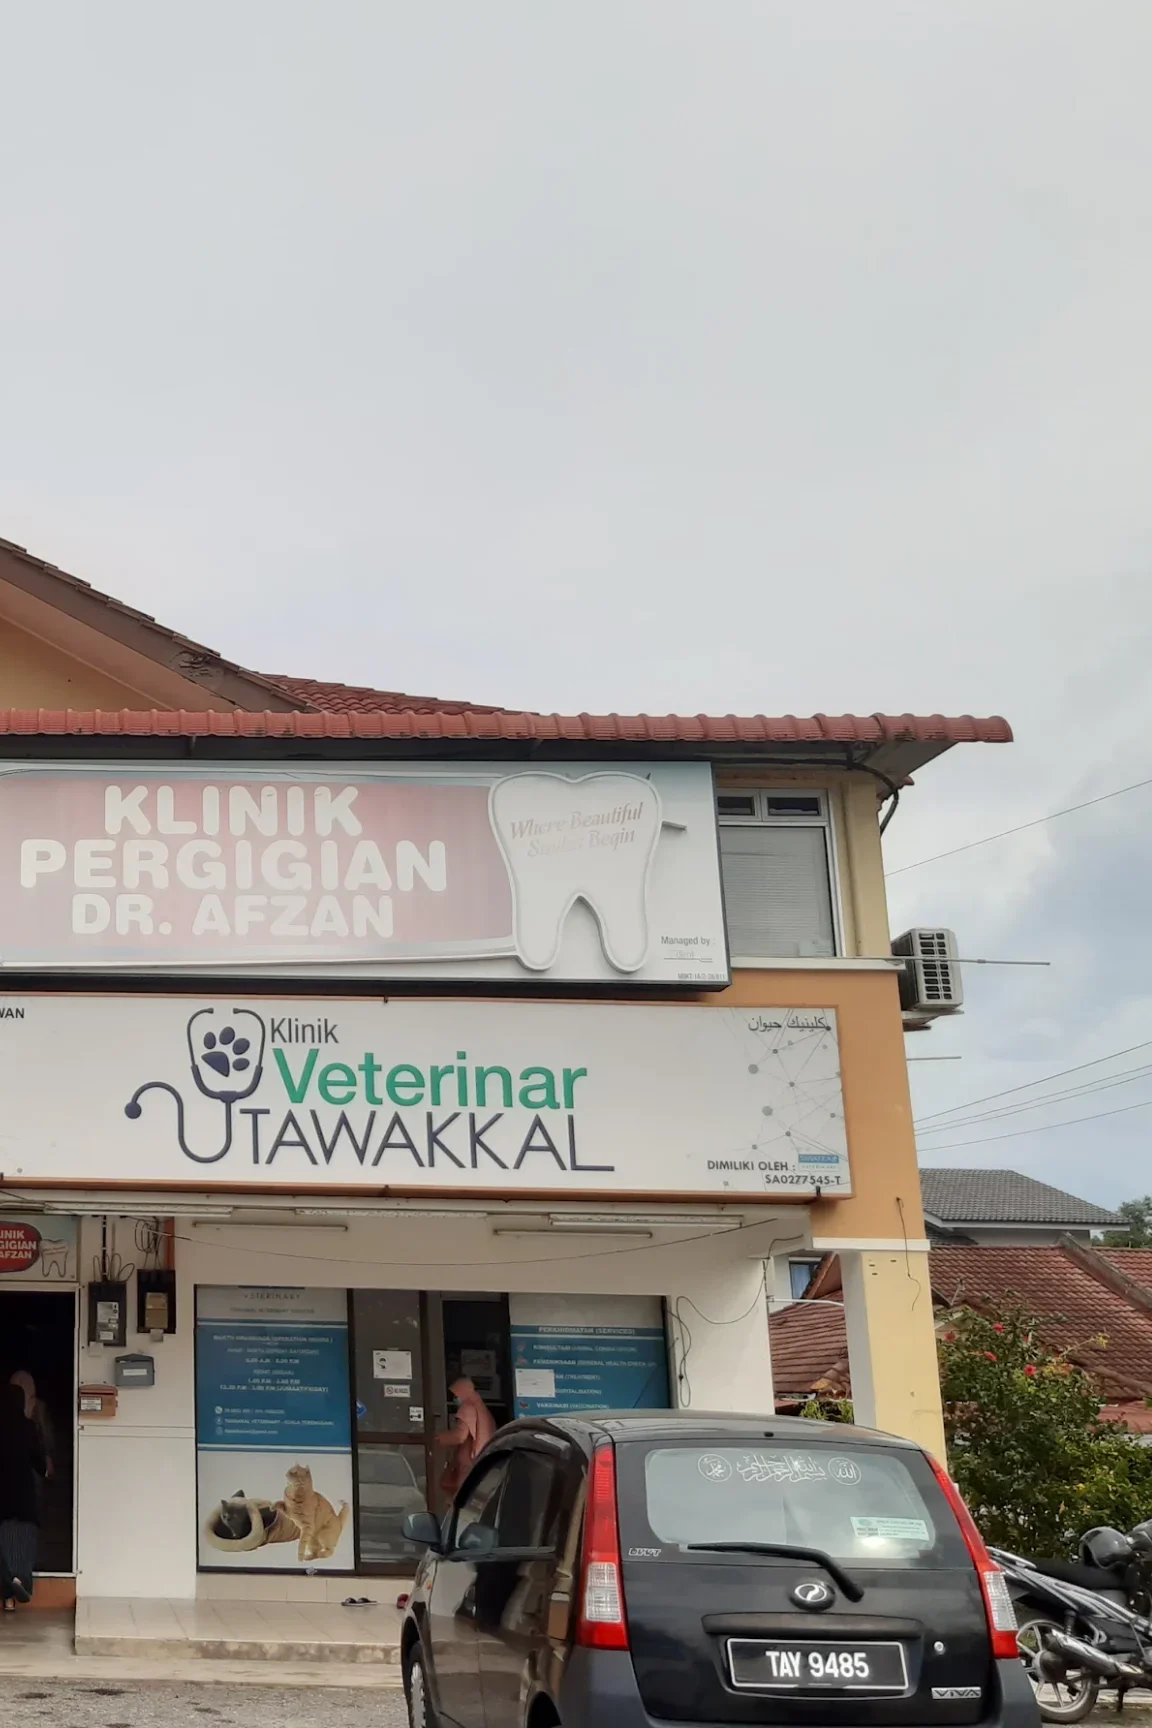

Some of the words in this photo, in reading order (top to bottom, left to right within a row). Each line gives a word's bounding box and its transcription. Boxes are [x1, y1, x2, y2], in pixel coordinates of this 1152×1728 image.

[103, 784, 363, 837] KLINIK
[570, 801, 644, 830] Beautiful
[589, 828, 635, 852] Begin
[19, 838, 447, 891] PERGIGIAN
[70, 893, 172, 937] DR.
[192, 894, 395, 939] AFZAN
[661, 936, 698, 946] Managed
[271, 1018, 339, 1043] Klinik
[748, 1016, 782, 1032] حيوان
[273, 1048, 588, 1110] Veterinar
[239, 1108, 615, 1171] TAWAKKAL
[707, 1160, 754, 1171] DIMILIKI
[758, 1162, 788, 1171] OLEH
[765, 1175, 841, 1185] SA0277545-T
[628, 1547, 663, 1558] DVVT
[766, 1651, 802, 1677] TAY
[808, 1652, 870, 1679] 9485
[933, 1688, 982, 1699] VIVA
